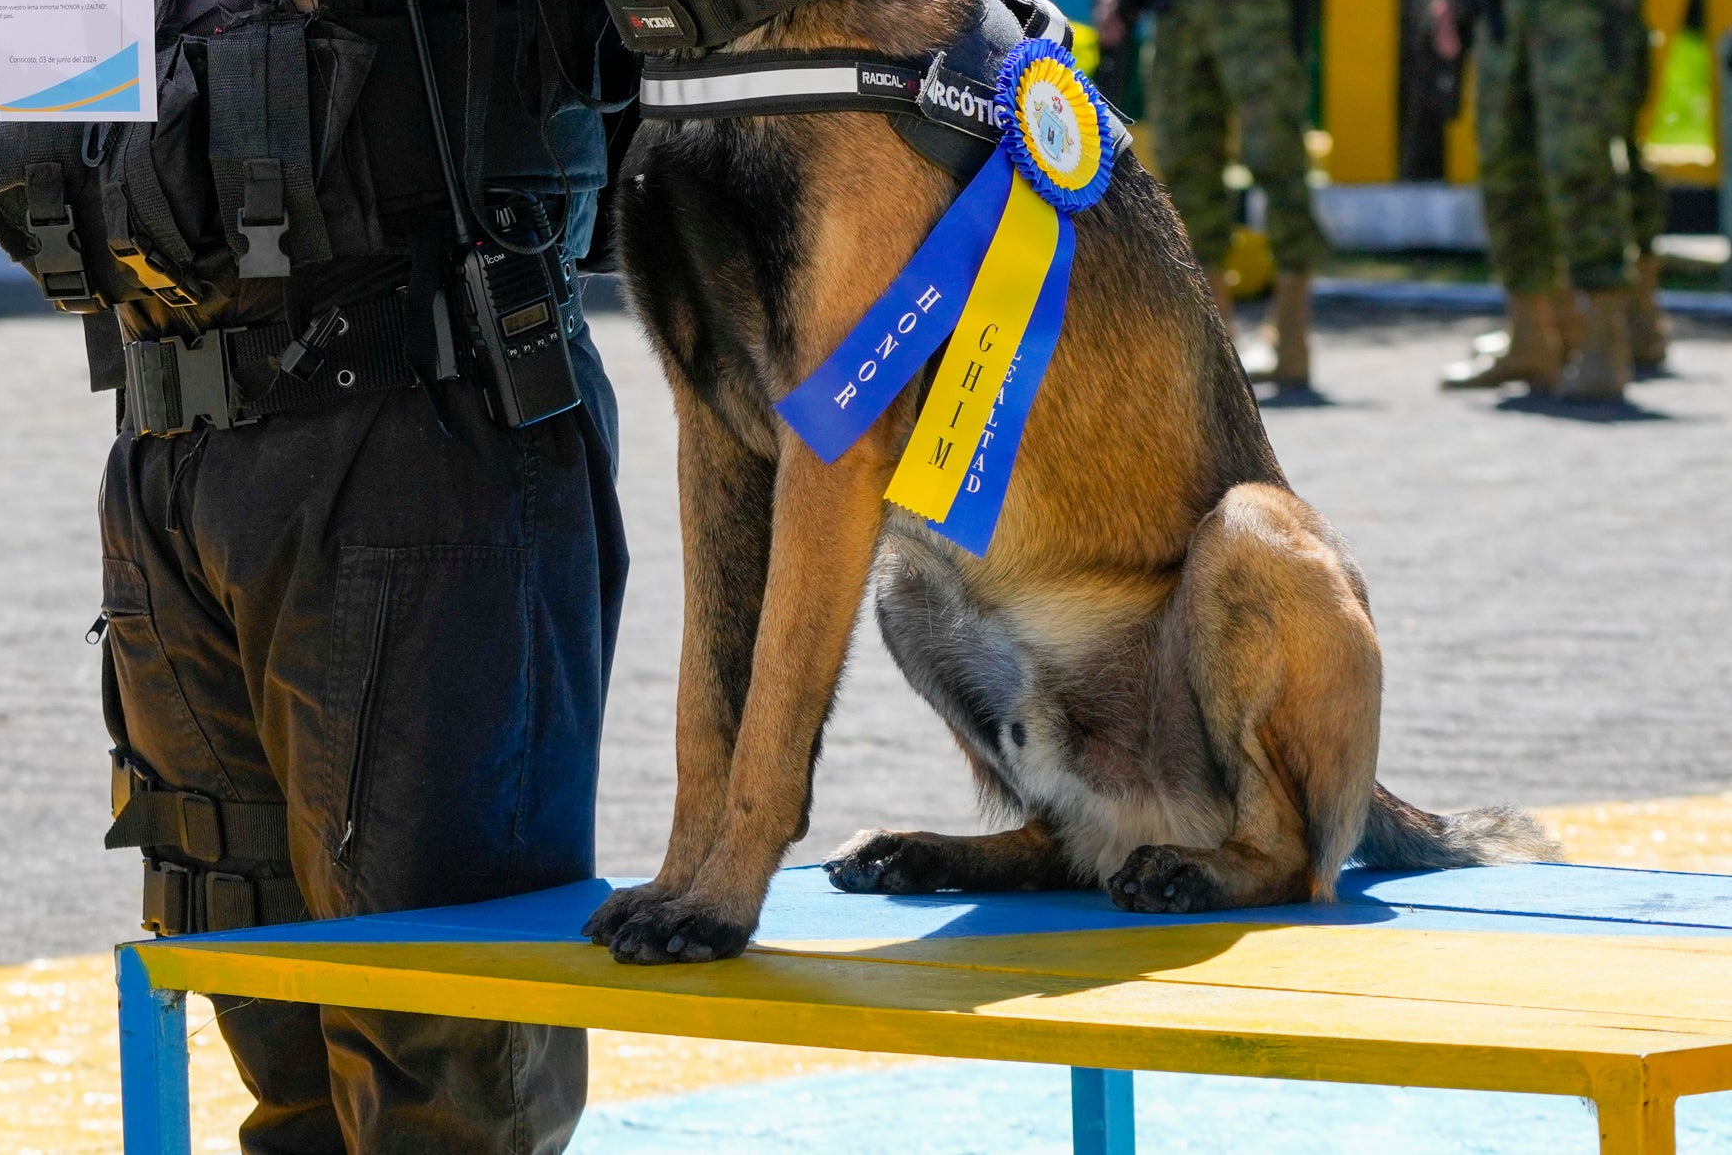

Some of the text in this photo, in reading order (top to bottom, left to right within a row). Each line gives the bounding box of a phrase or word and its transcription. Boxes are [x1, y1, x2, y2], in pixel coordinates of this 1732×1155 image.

[8, 55, 97, 65] Conocoto, 03 de junio del 2024
[834, 283, 942, 410] HONOR
[927, 323, 999, 471] GHIM
